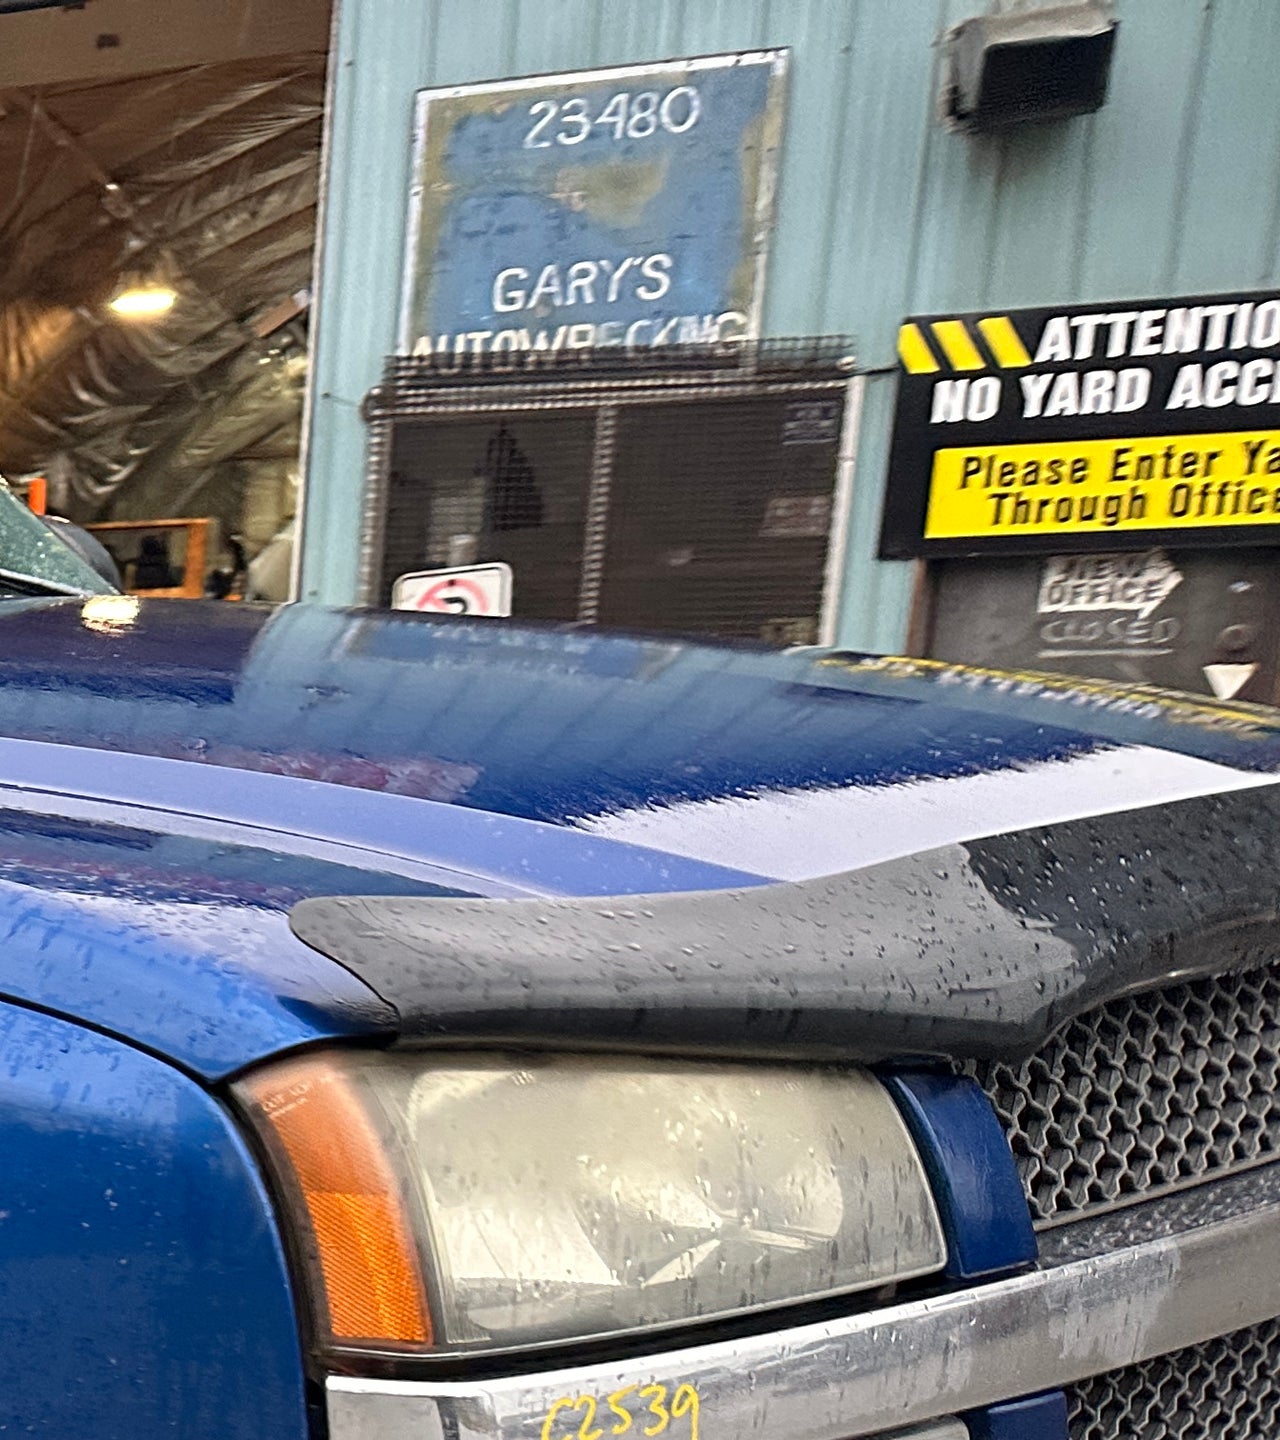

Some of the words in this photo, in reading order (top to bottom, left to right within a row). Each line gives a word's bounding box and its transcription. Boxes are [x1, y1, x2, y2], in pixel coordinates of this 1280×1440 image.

[522, 85, 701, 149] 23480
[492, 253, 673, 312] GARY'S
[930, 376, 1002, 424] NO
[1019, 367, 1152, 418] YARD
[959, 454, 1089, 490] Please
[1108, 445, 1223, 482] Enter
[988, 486, 1149, 526] Through
[1047, 577, 1165, 607] OFFICE
[1040, 616, 1183, 645] CLOSED
